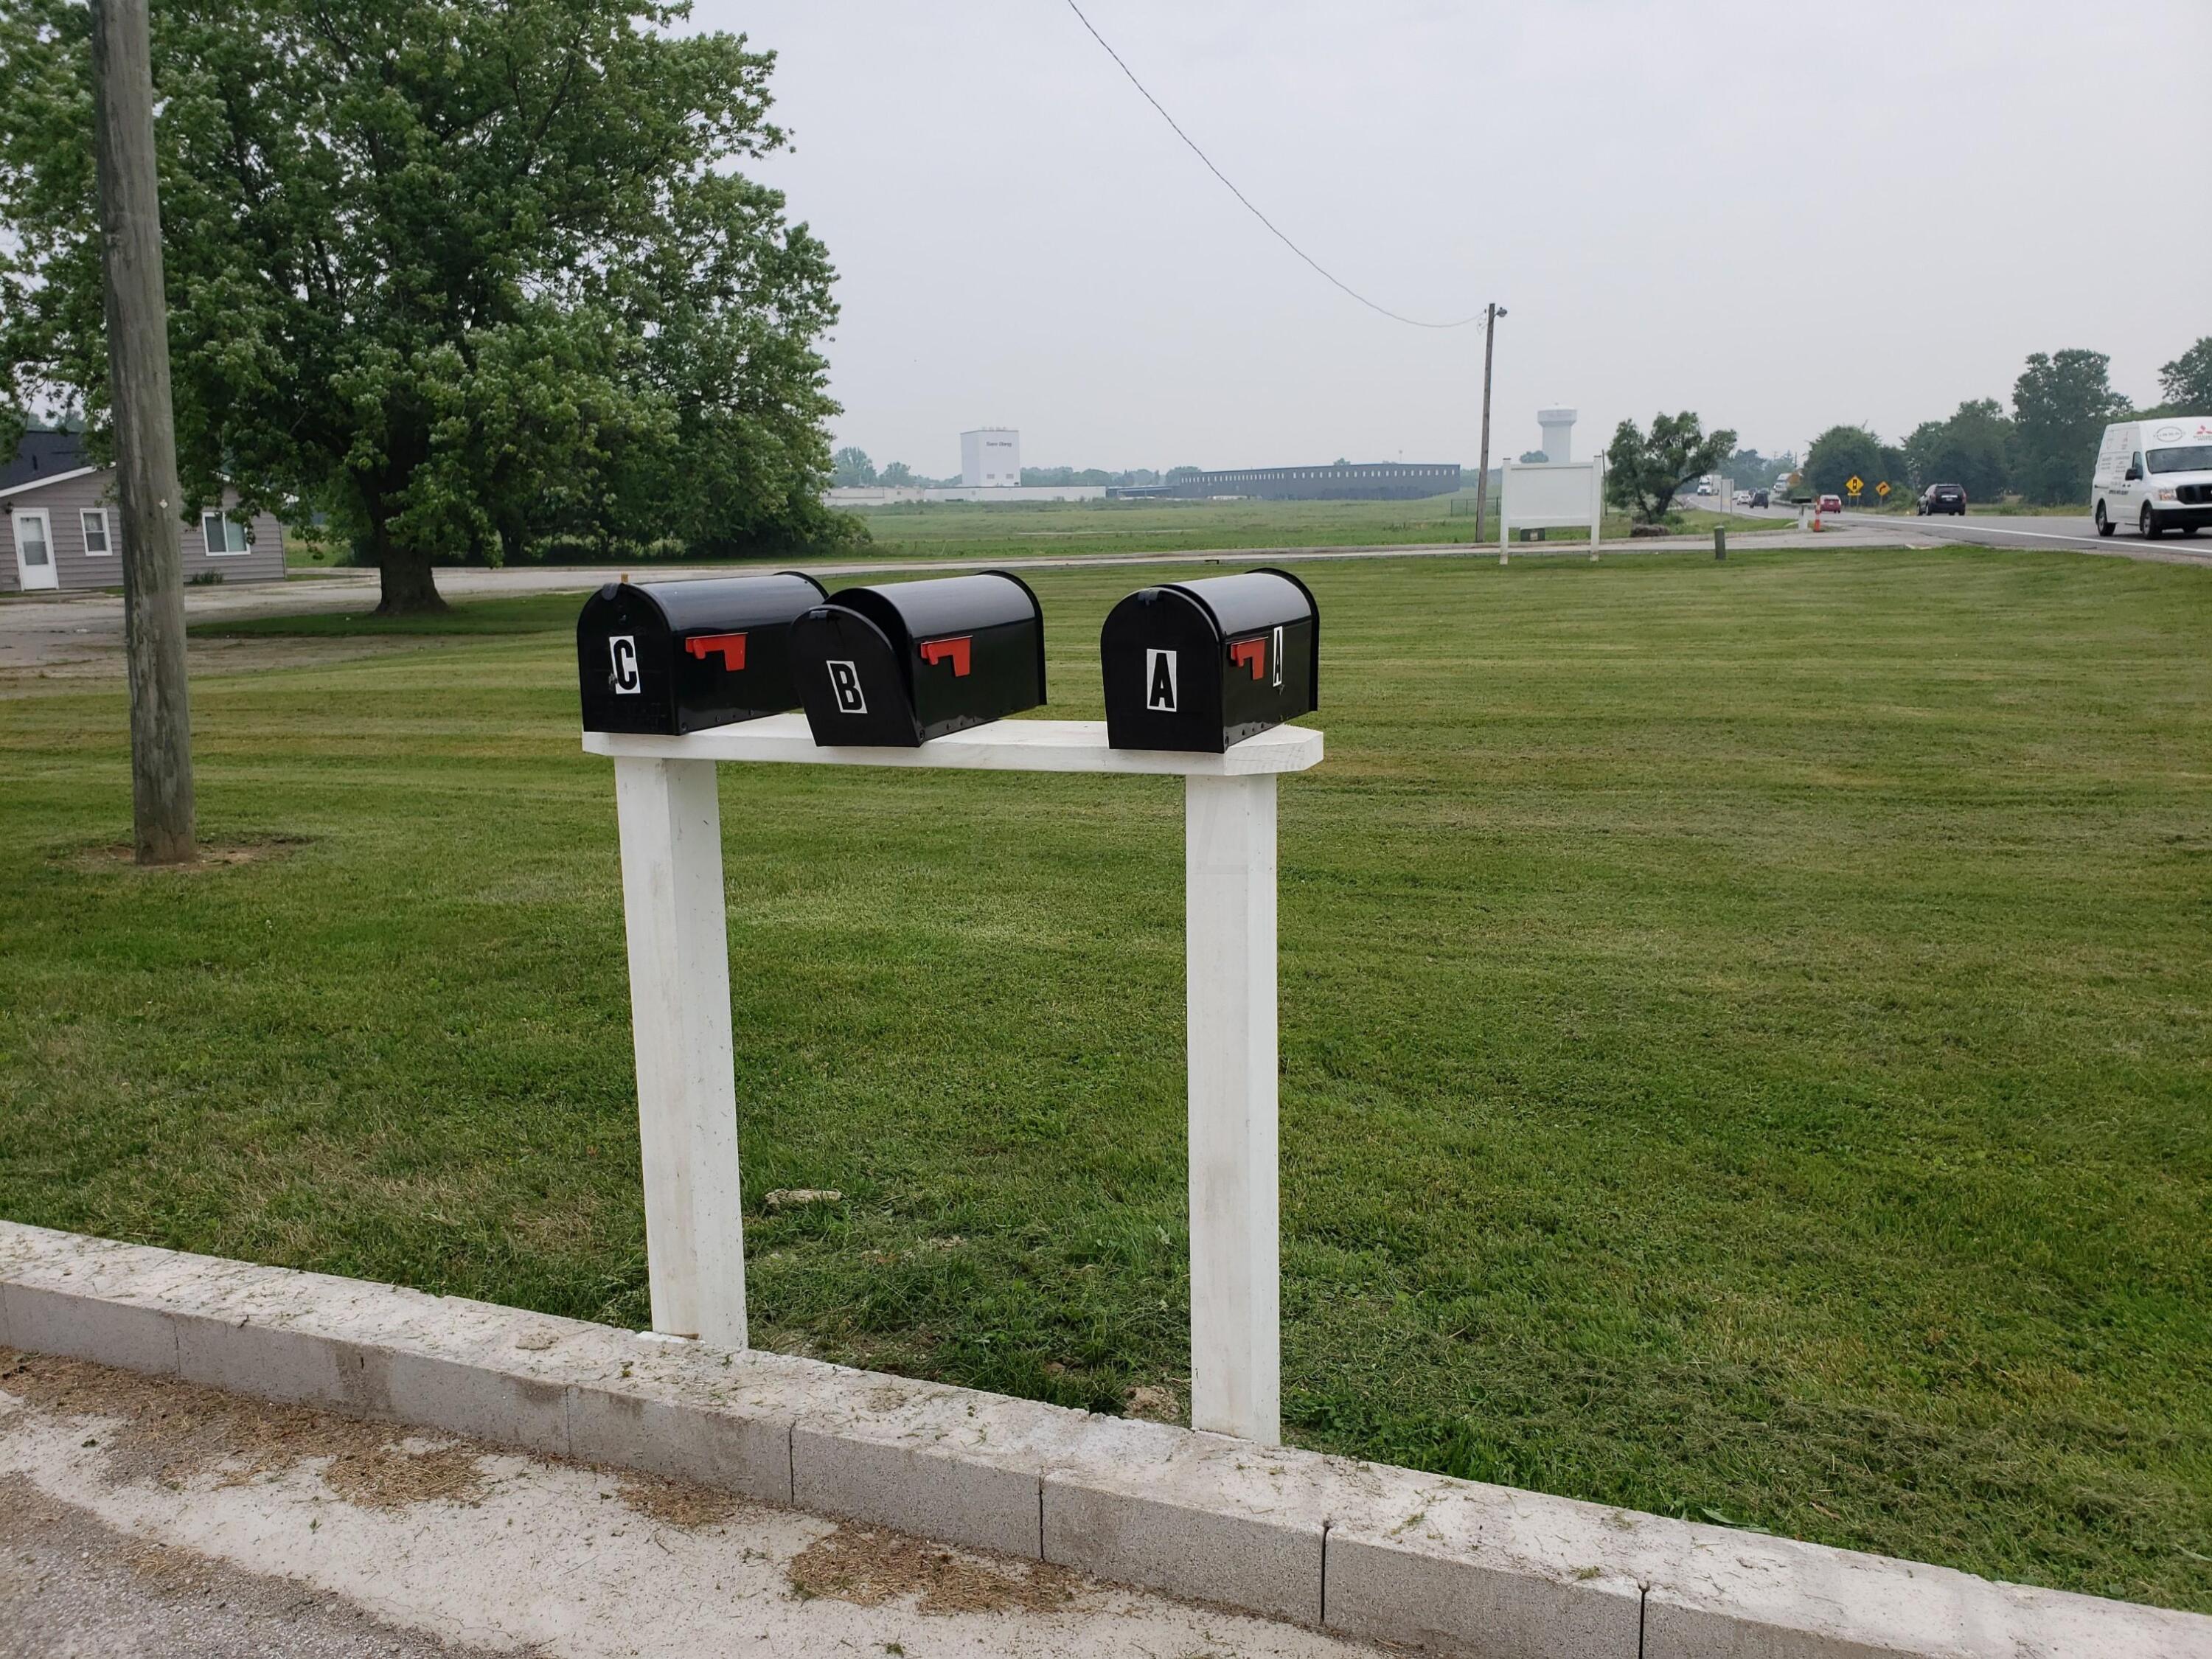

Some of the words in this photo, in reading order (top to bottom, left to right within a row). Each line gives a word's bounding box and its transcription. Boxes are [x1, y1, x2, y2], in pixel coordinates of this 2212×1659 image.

[613, 639, 637, 690] C
[1149, 652, 1175, 709] A
[1273, 628, 1282, 684] A
[830, 664, 862, 710] B
